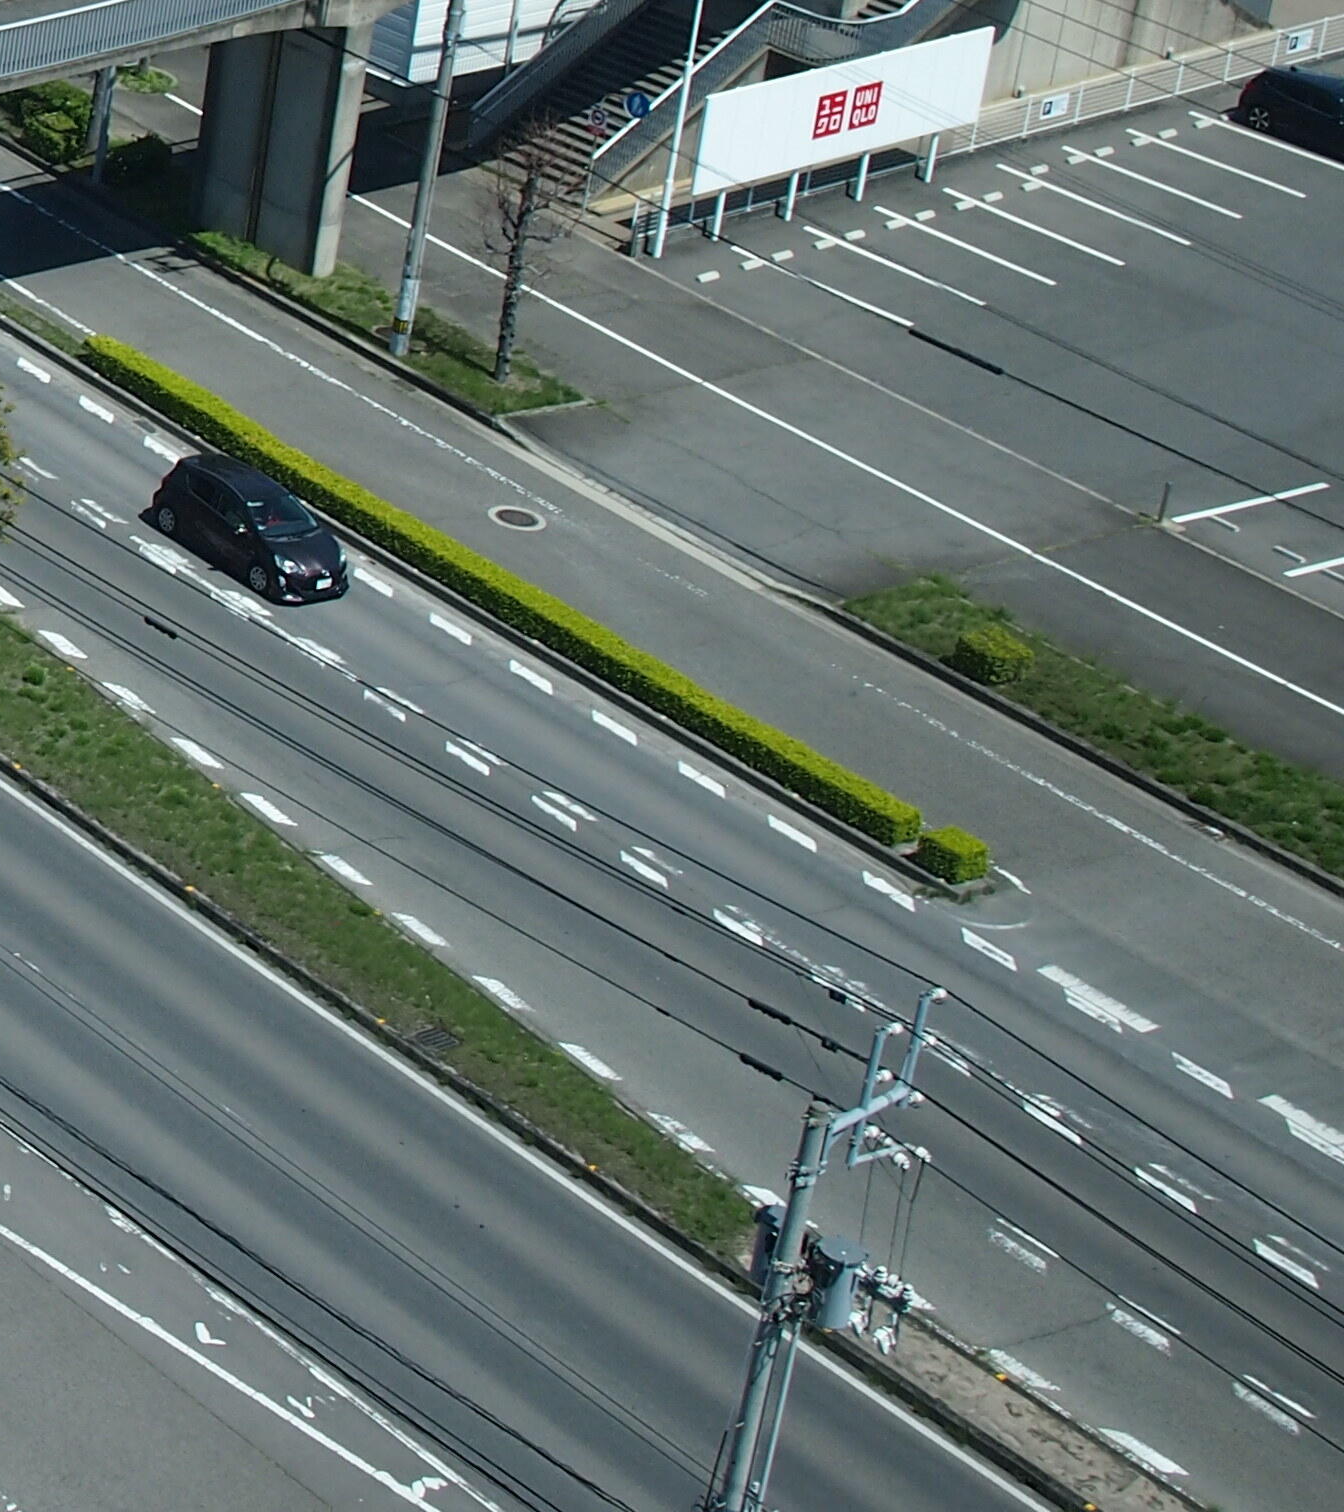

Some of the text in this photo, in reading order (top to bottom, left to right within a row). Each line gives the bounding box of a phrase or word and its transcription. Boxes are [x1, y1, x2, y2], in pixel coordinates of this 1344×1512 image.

[820, 95, 844, 116] ユニ
[855, 87, 878, 107] UNI
[815, 113, 842, 135] クロ
[852, 104, 876, 126] QLO
